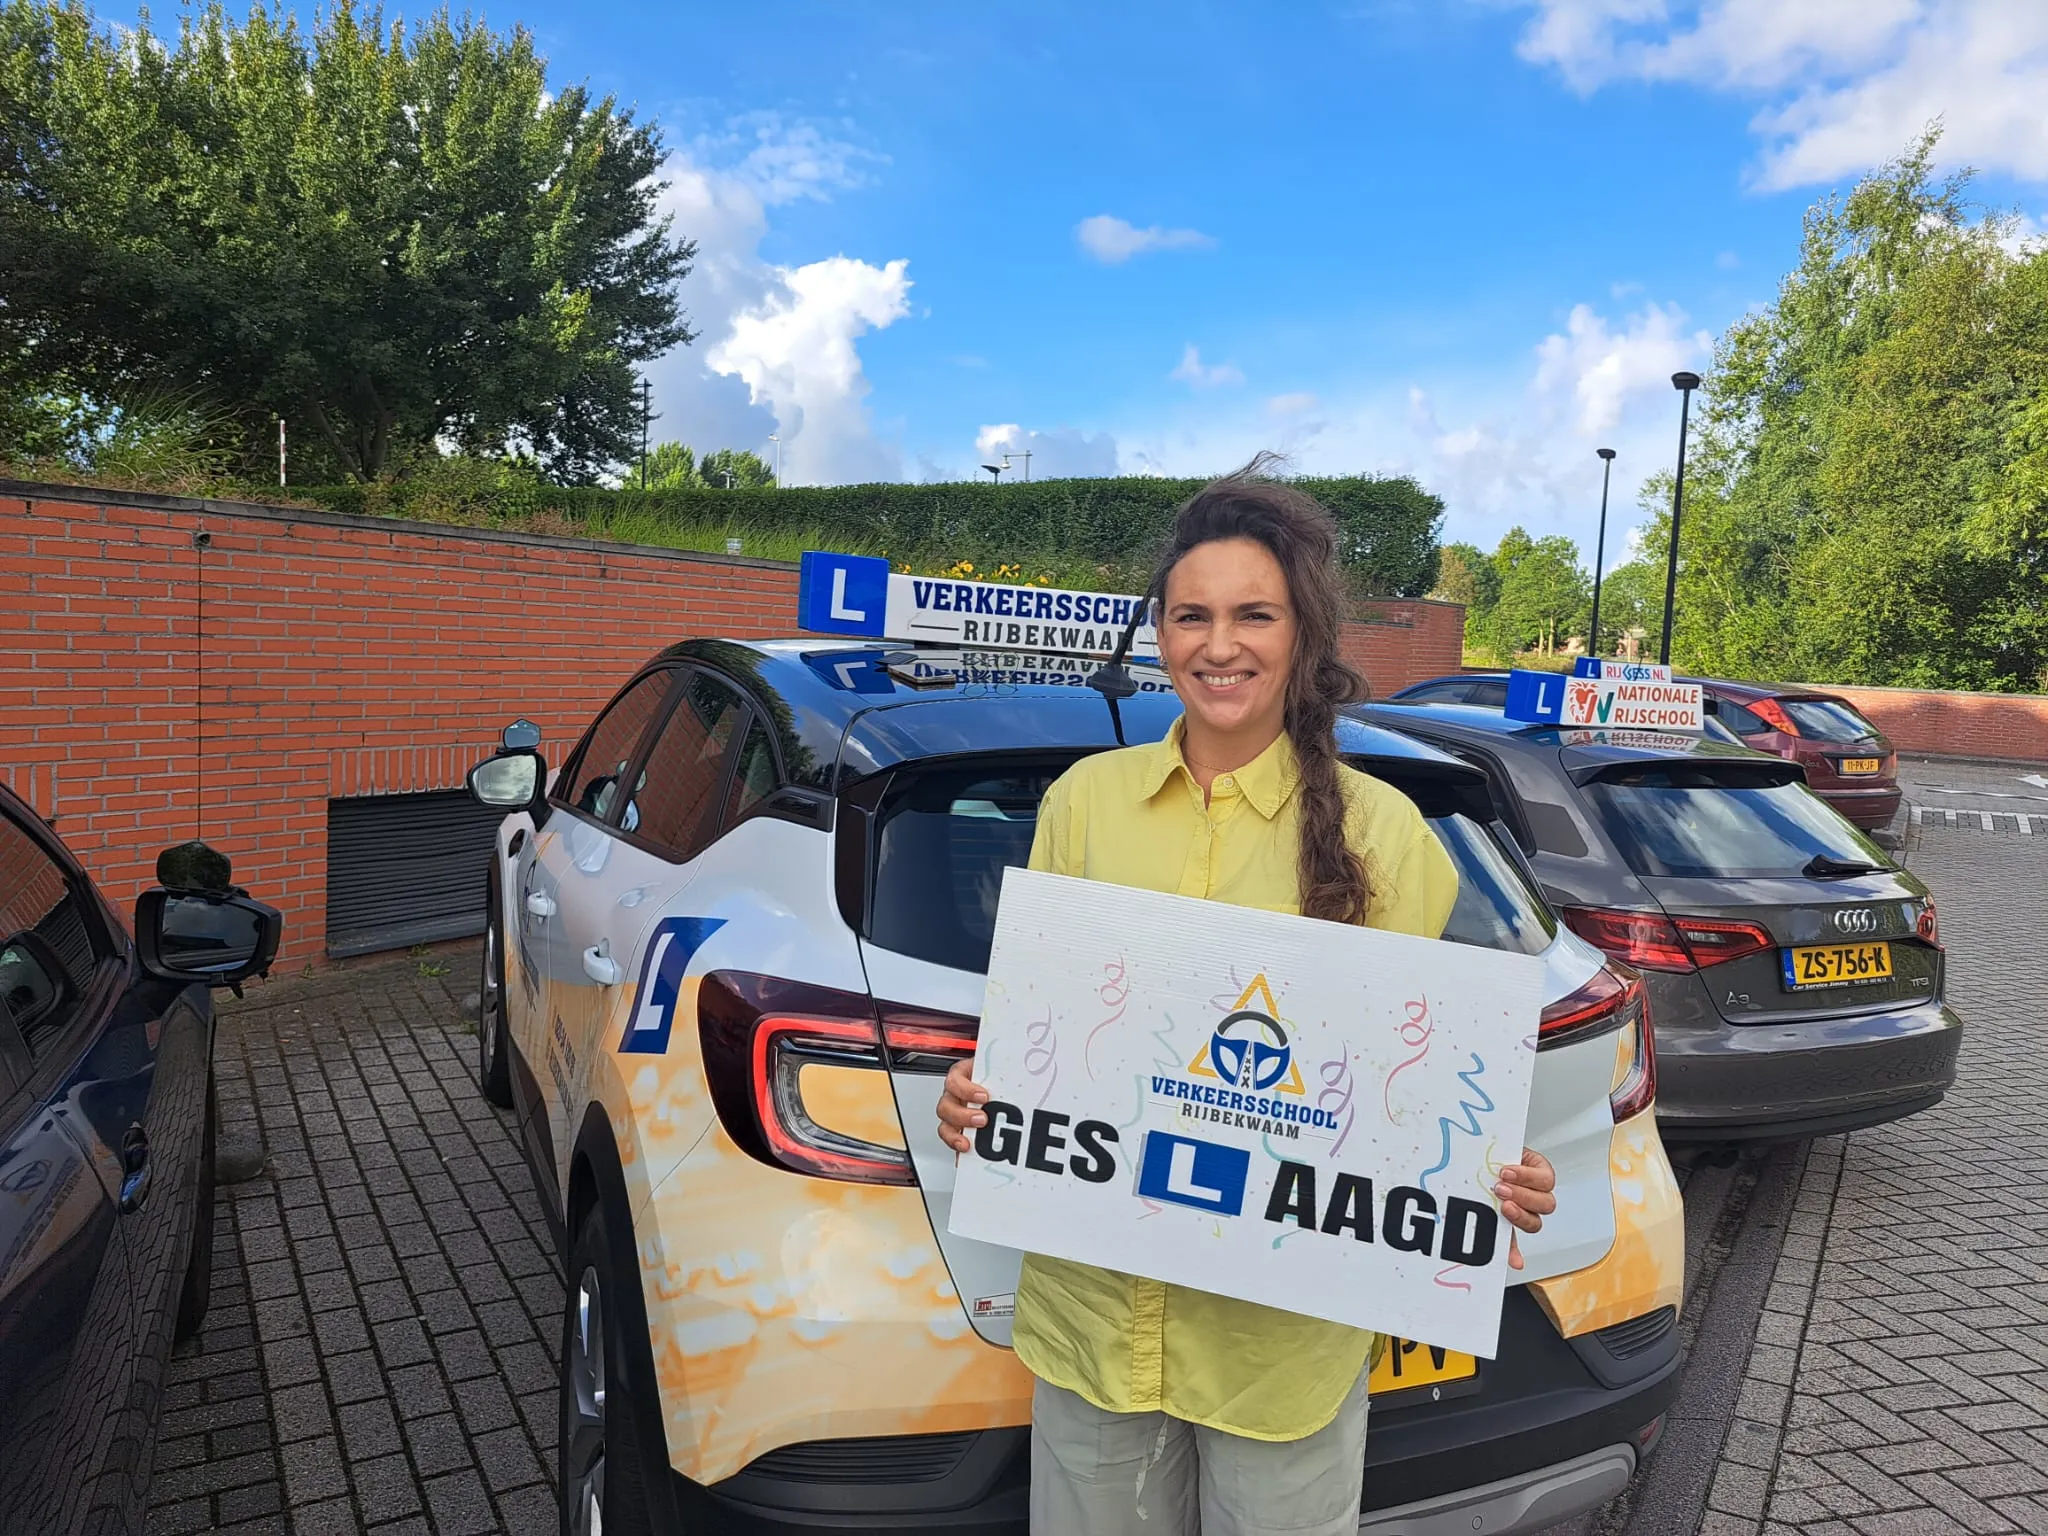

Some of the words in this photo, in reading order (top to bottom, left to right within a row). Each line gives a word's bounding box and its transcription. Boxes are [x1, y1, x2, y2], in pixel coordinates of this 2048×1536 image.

[829, 568, 867, 622] L
[1586, 662, 1595, 678] L
[1536, 682, 1552, 714] L
[1617, 685, 1699, 704] NATIONALE
[1614, 708, 1697, 726] RIJSCHOOL
[1847, 760, 1875, 771] 11-PK-JF
[1801, 946, 1887, 979] ZS-756-K
[633, 932, 675, 1031] L
[1726, 991, 1750, 1005] A3
[1152, 1076, 1338, 1129] VERKEERSSCHOOL
[1181, 1103, 1300, 1139] RIJBEKWAAM
[974, 1100, 1120, 1183] GES
[1166, 1142, 1222, 1203] L
[1264, 1160, 1499, 1267] AAGD
